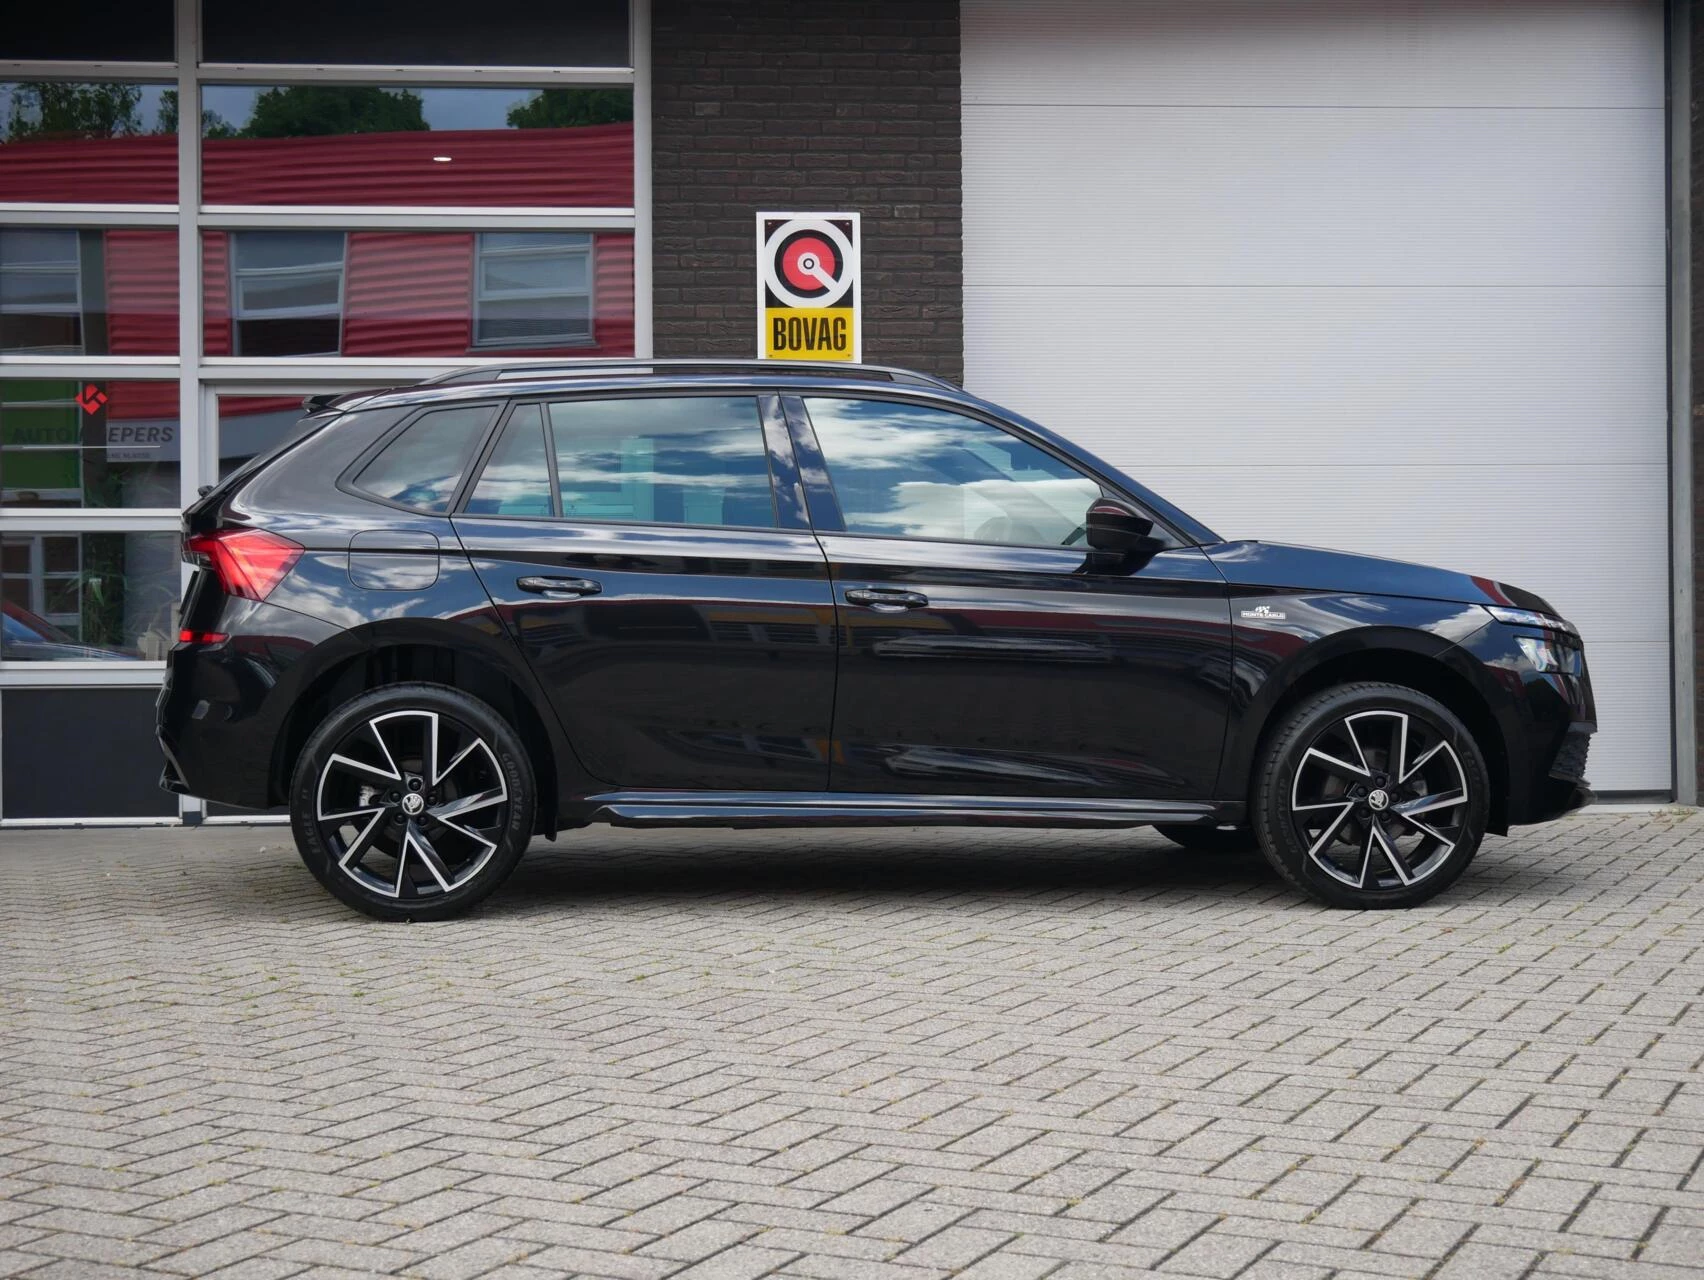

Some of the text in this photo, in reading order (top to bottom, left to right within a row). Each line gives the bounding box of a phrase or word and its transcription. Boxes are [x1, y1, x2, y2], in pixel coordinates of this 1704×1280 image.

[772, 316, 847, 351] BOVAG
[12, 427, 174, 443] AUTO EPERS
[501, 751, 523, 831] GOODYEAR
